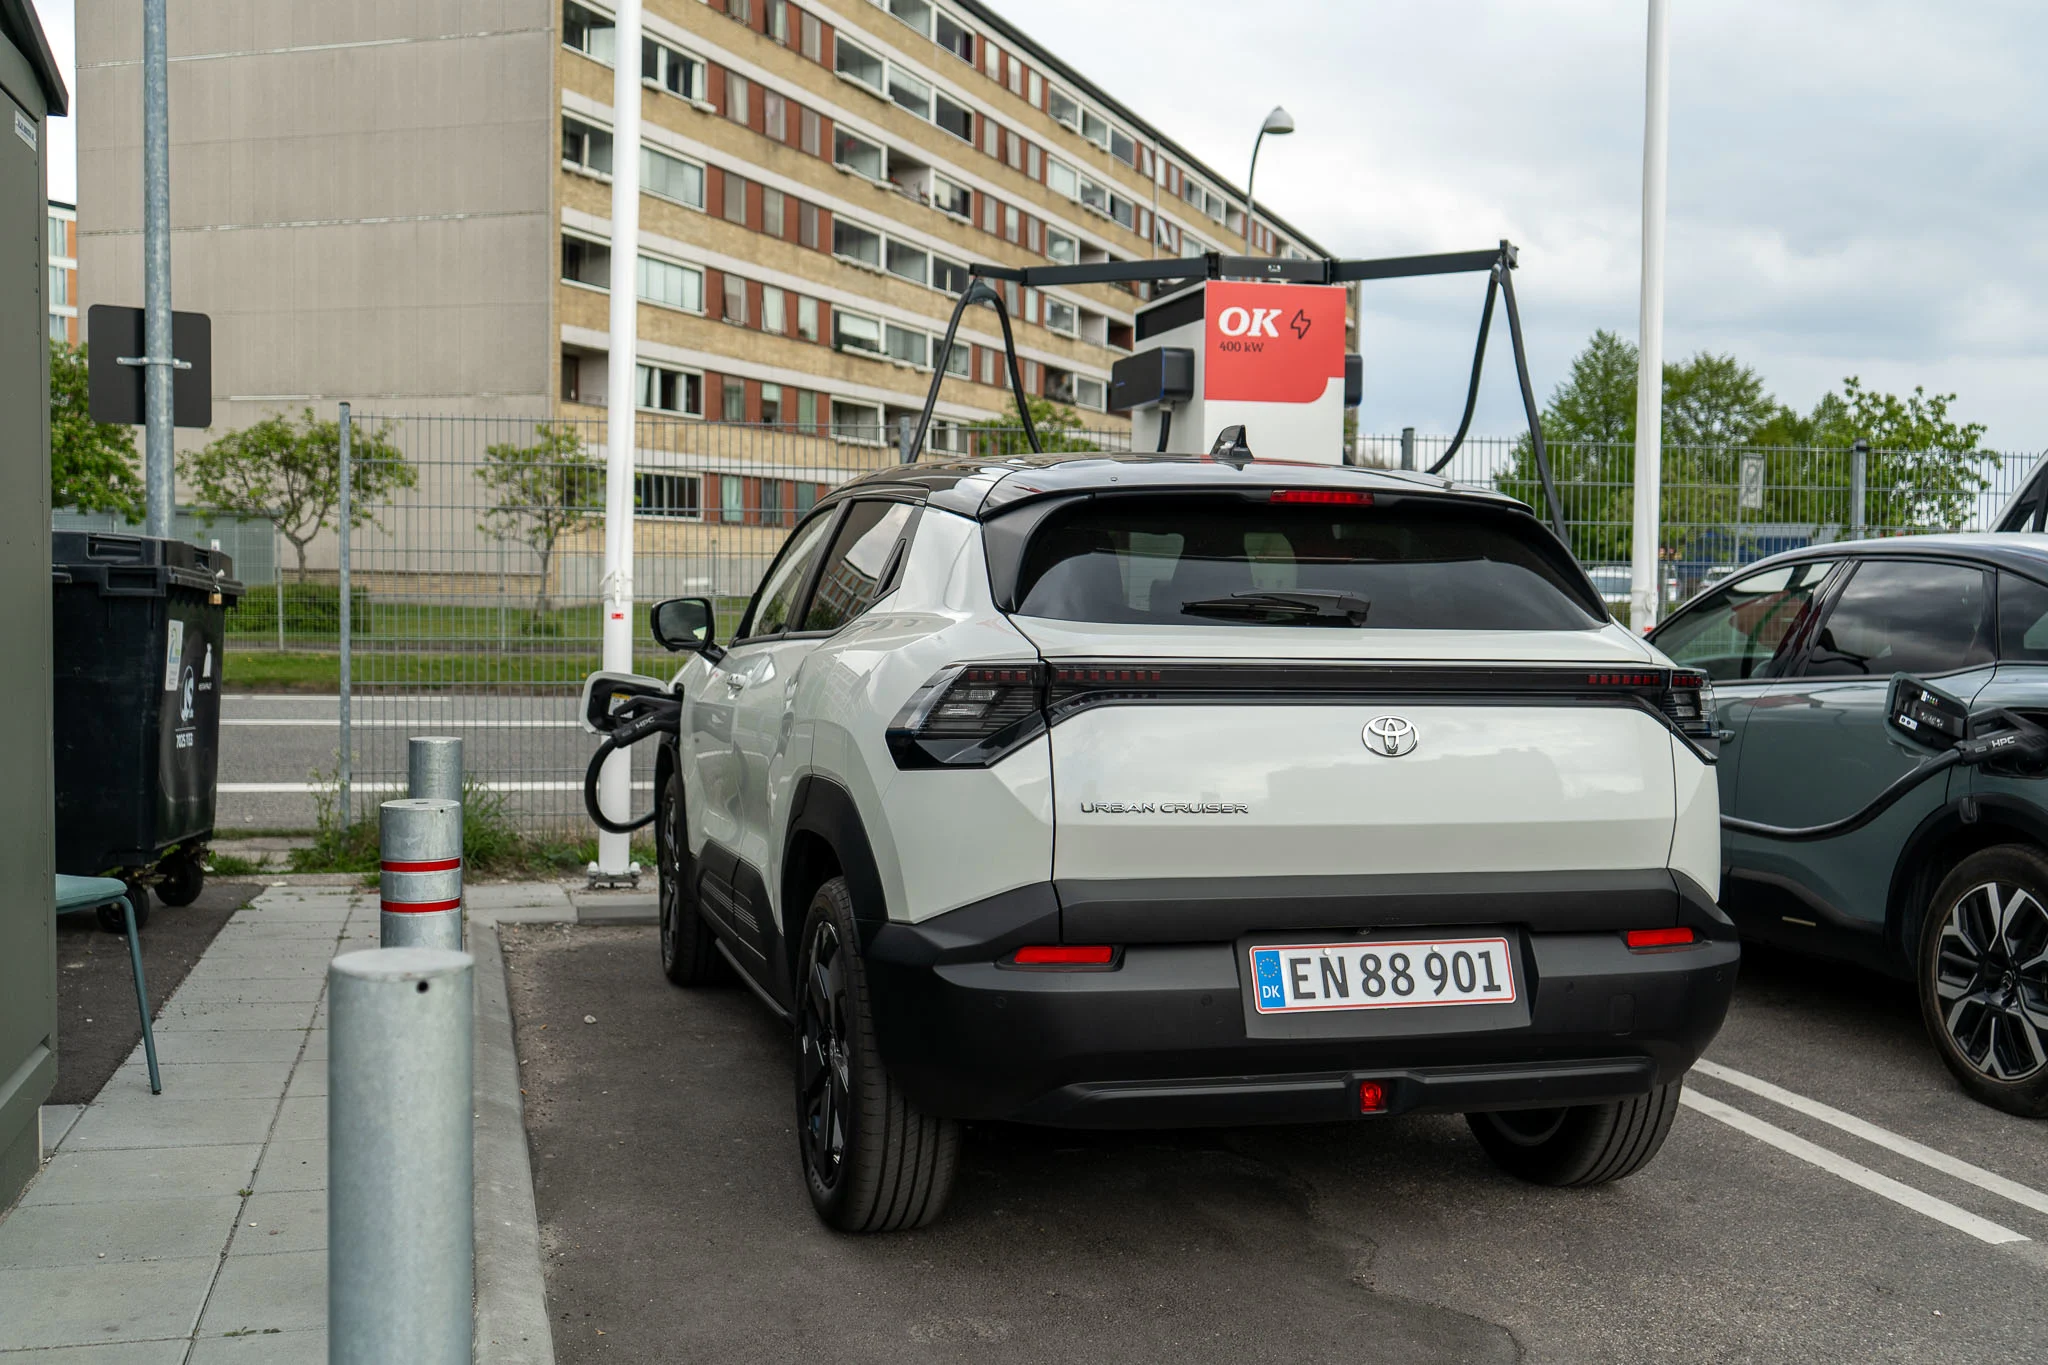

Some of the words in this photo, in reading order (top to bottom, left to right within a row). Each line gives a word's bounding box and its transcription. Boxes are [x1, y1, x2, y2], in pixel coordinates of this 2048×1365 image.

[1218, 306, 1282, 337] OK
[1219, 341, 1241, 353] 400
[1243, 341, 1264, 353] kW
[635, 716, 655, 728] HPC
[1991, 735, 2015, 748] HPC
[1080, 802, 1156, 814] URBAN
[1160, 802, 1249, 814] CRUISER
[1289, 955, 1350, 1000] EN
[1359, 952, 1415, 998] 88
[1424, 949, 1502, 996] 901
[1262, 985, 1281, 999] DK
